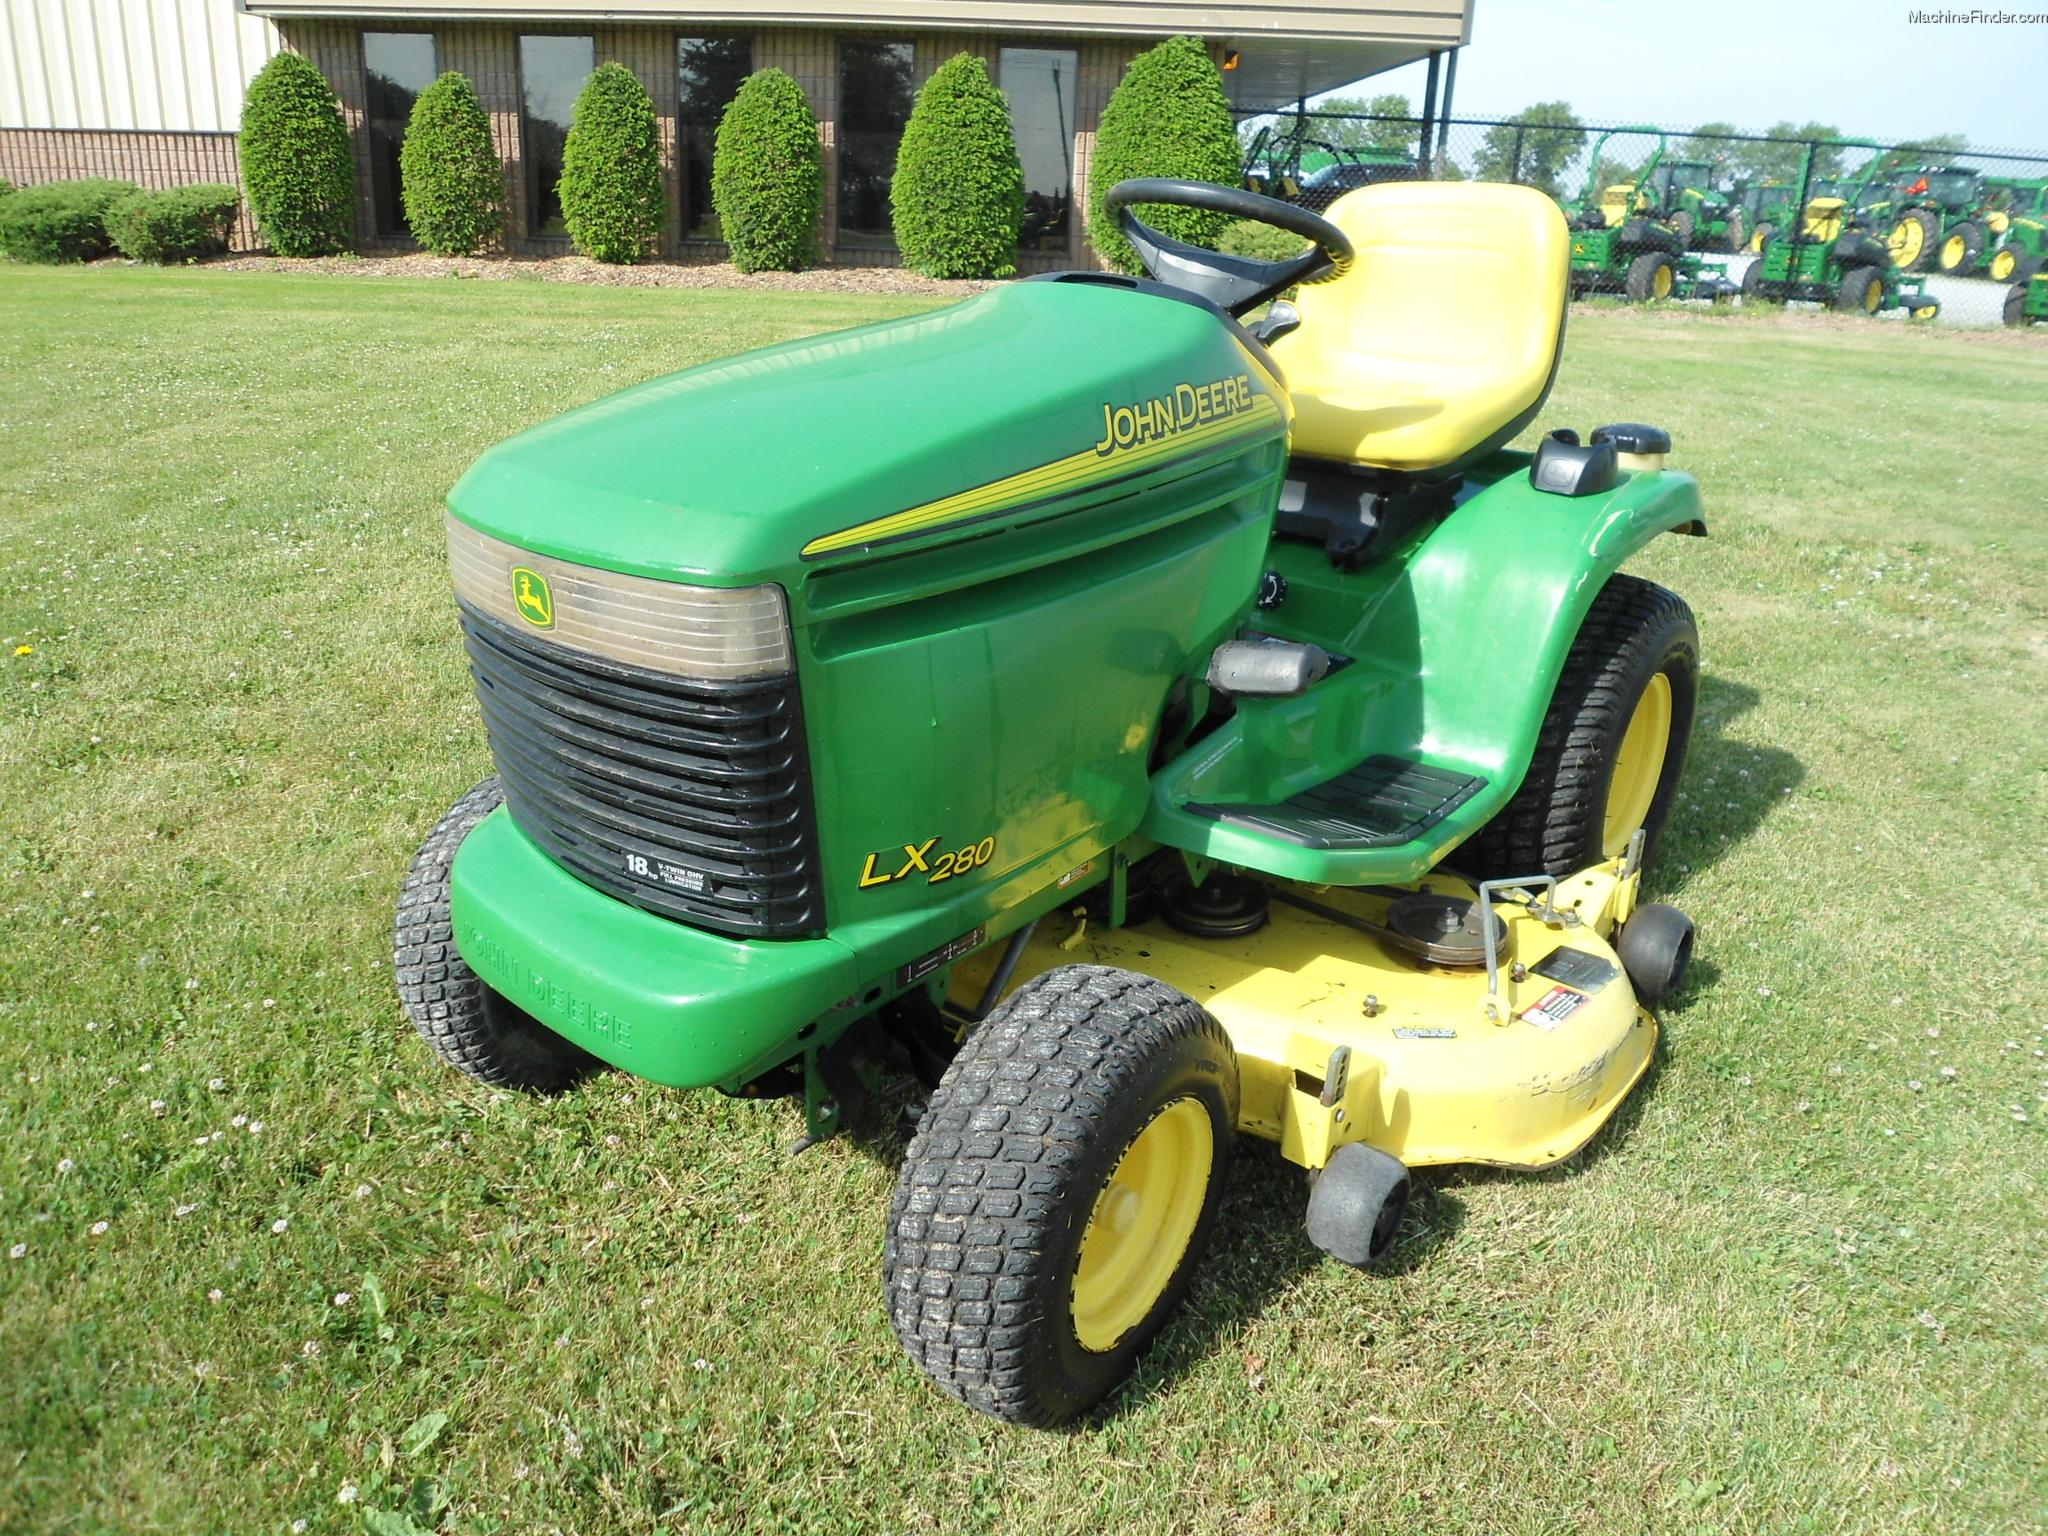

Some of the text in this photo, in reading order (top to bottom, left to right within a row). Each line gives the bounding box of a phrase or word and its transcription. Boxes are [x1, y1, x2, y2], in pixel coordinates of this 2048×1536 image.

[1096, 374, 1253, 457] JOHN DEERE
[657, 862, 686, 876] V-TWIN
[459, 919, 632, 1051] JOHN DEERE
